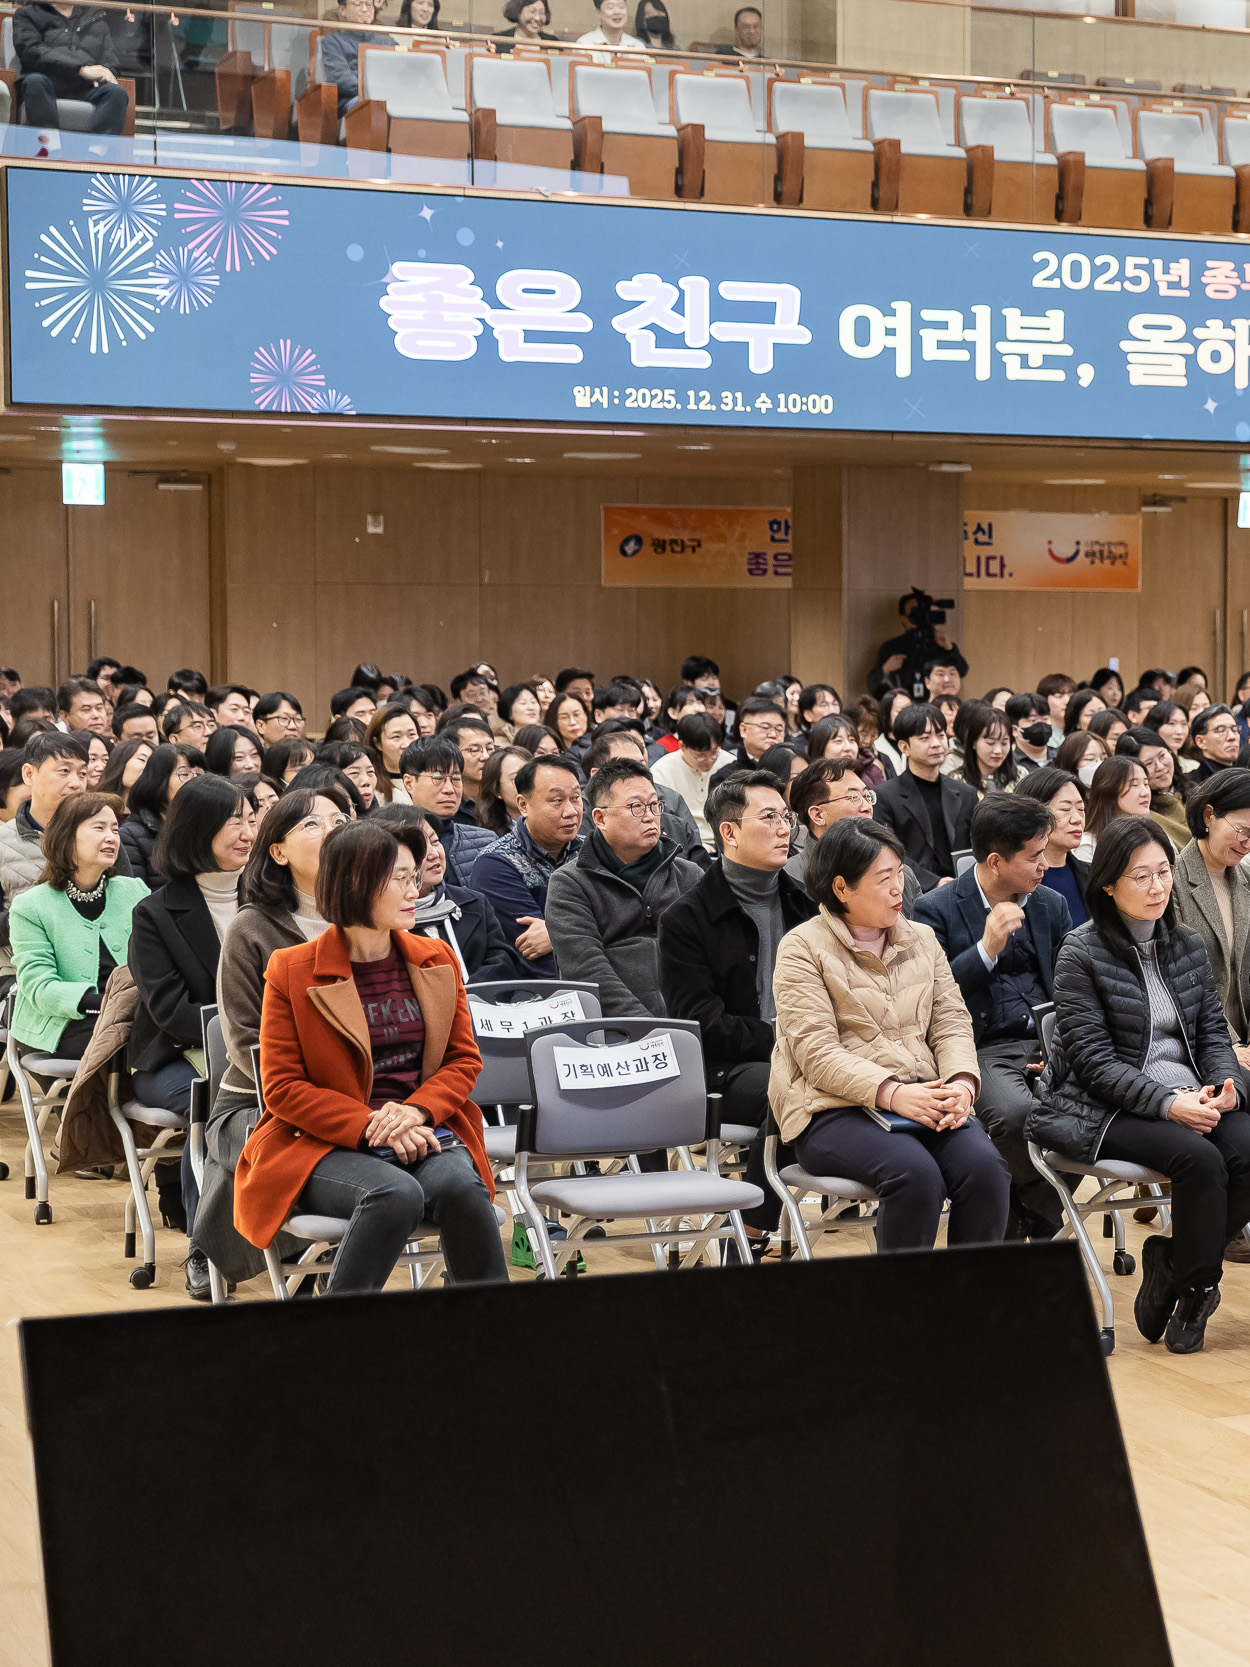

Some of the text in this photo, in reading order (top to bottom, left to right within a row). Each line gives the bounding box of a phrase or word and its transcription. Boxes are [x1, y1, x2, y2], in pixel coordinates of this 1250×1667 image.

[1031, 250, 1191, 298] 2025년
[379, 261, 594, 364] 좋은
[611, 273, 813, 375] 친구
[838, 300, 1096, 389] 여러분,
[573, 385, 609, 409] 일시
[624, 387, 682, 410] 2025.
[686, 390, 717, 411] 12.
[720, 391, 752, 412] 31.
[754, 392, 773, 414] 수
[777, 393, 834, 415] 10:00
[651, 537, 702, 555] 광진구
[747, 551, 792, 577] 좋은
[562, 1052, 669, 1080] 기획예산과장
